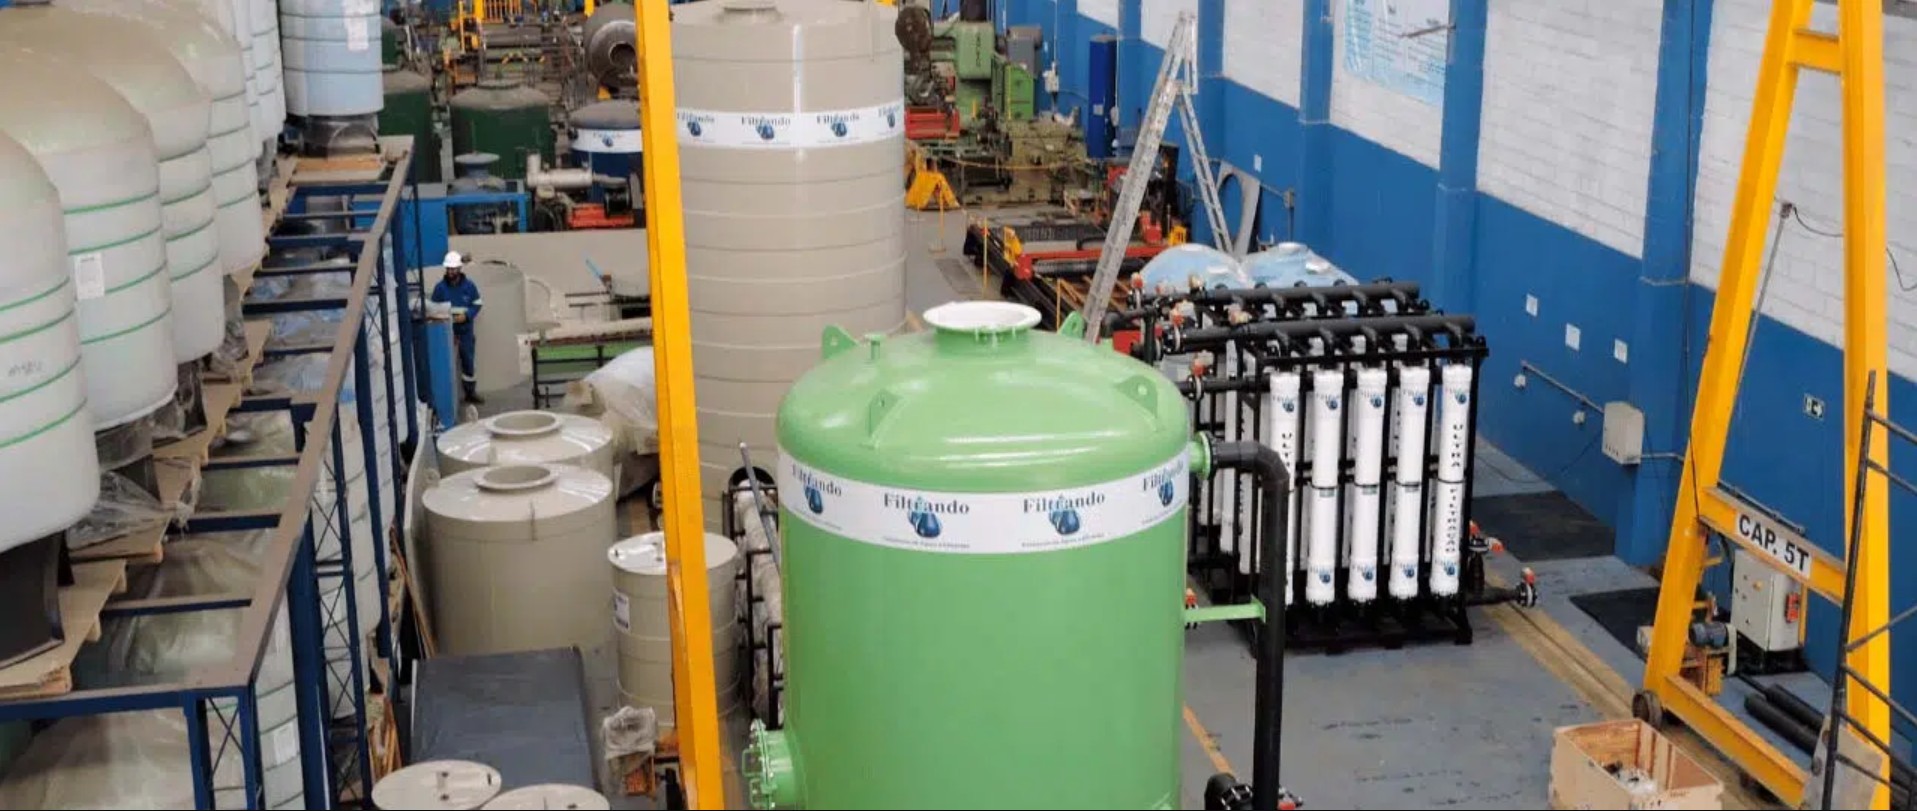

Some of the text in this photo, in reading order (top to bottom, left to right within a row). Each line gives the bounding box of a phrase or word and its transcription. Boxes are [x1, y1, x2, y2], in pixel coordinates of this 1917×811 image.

[884, 493, 970, 514] Filtrando
[1023, 491, 1106, 514] Filtrando
[1739, 513, 1809, 571] CAP. 5T
